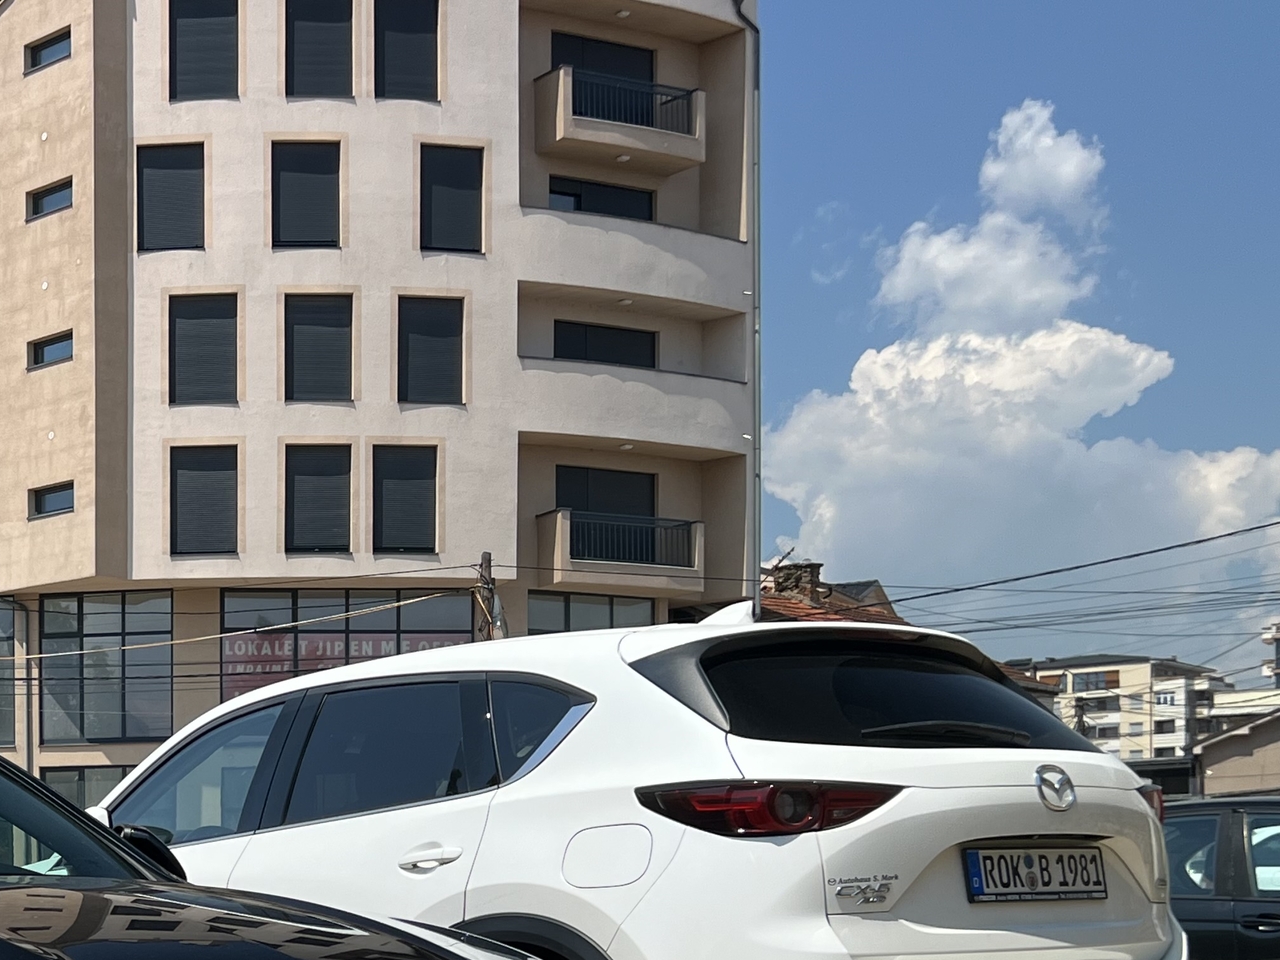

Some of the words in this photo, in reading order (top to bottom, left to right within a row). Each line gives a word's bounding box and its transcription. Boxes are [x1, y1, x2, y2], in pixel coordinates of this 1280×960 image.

[225, 640, 308, 656] LOKALET
[316, 640, 373, 656] JIPEN
[380, 640, 411, 656] ME
[982, 854, 1025, 889] ROK
[1038, 854, 1052, 887] B
[1055, 854, 1102, 887] 1981
[835, 882, 892, 896] CX-5
